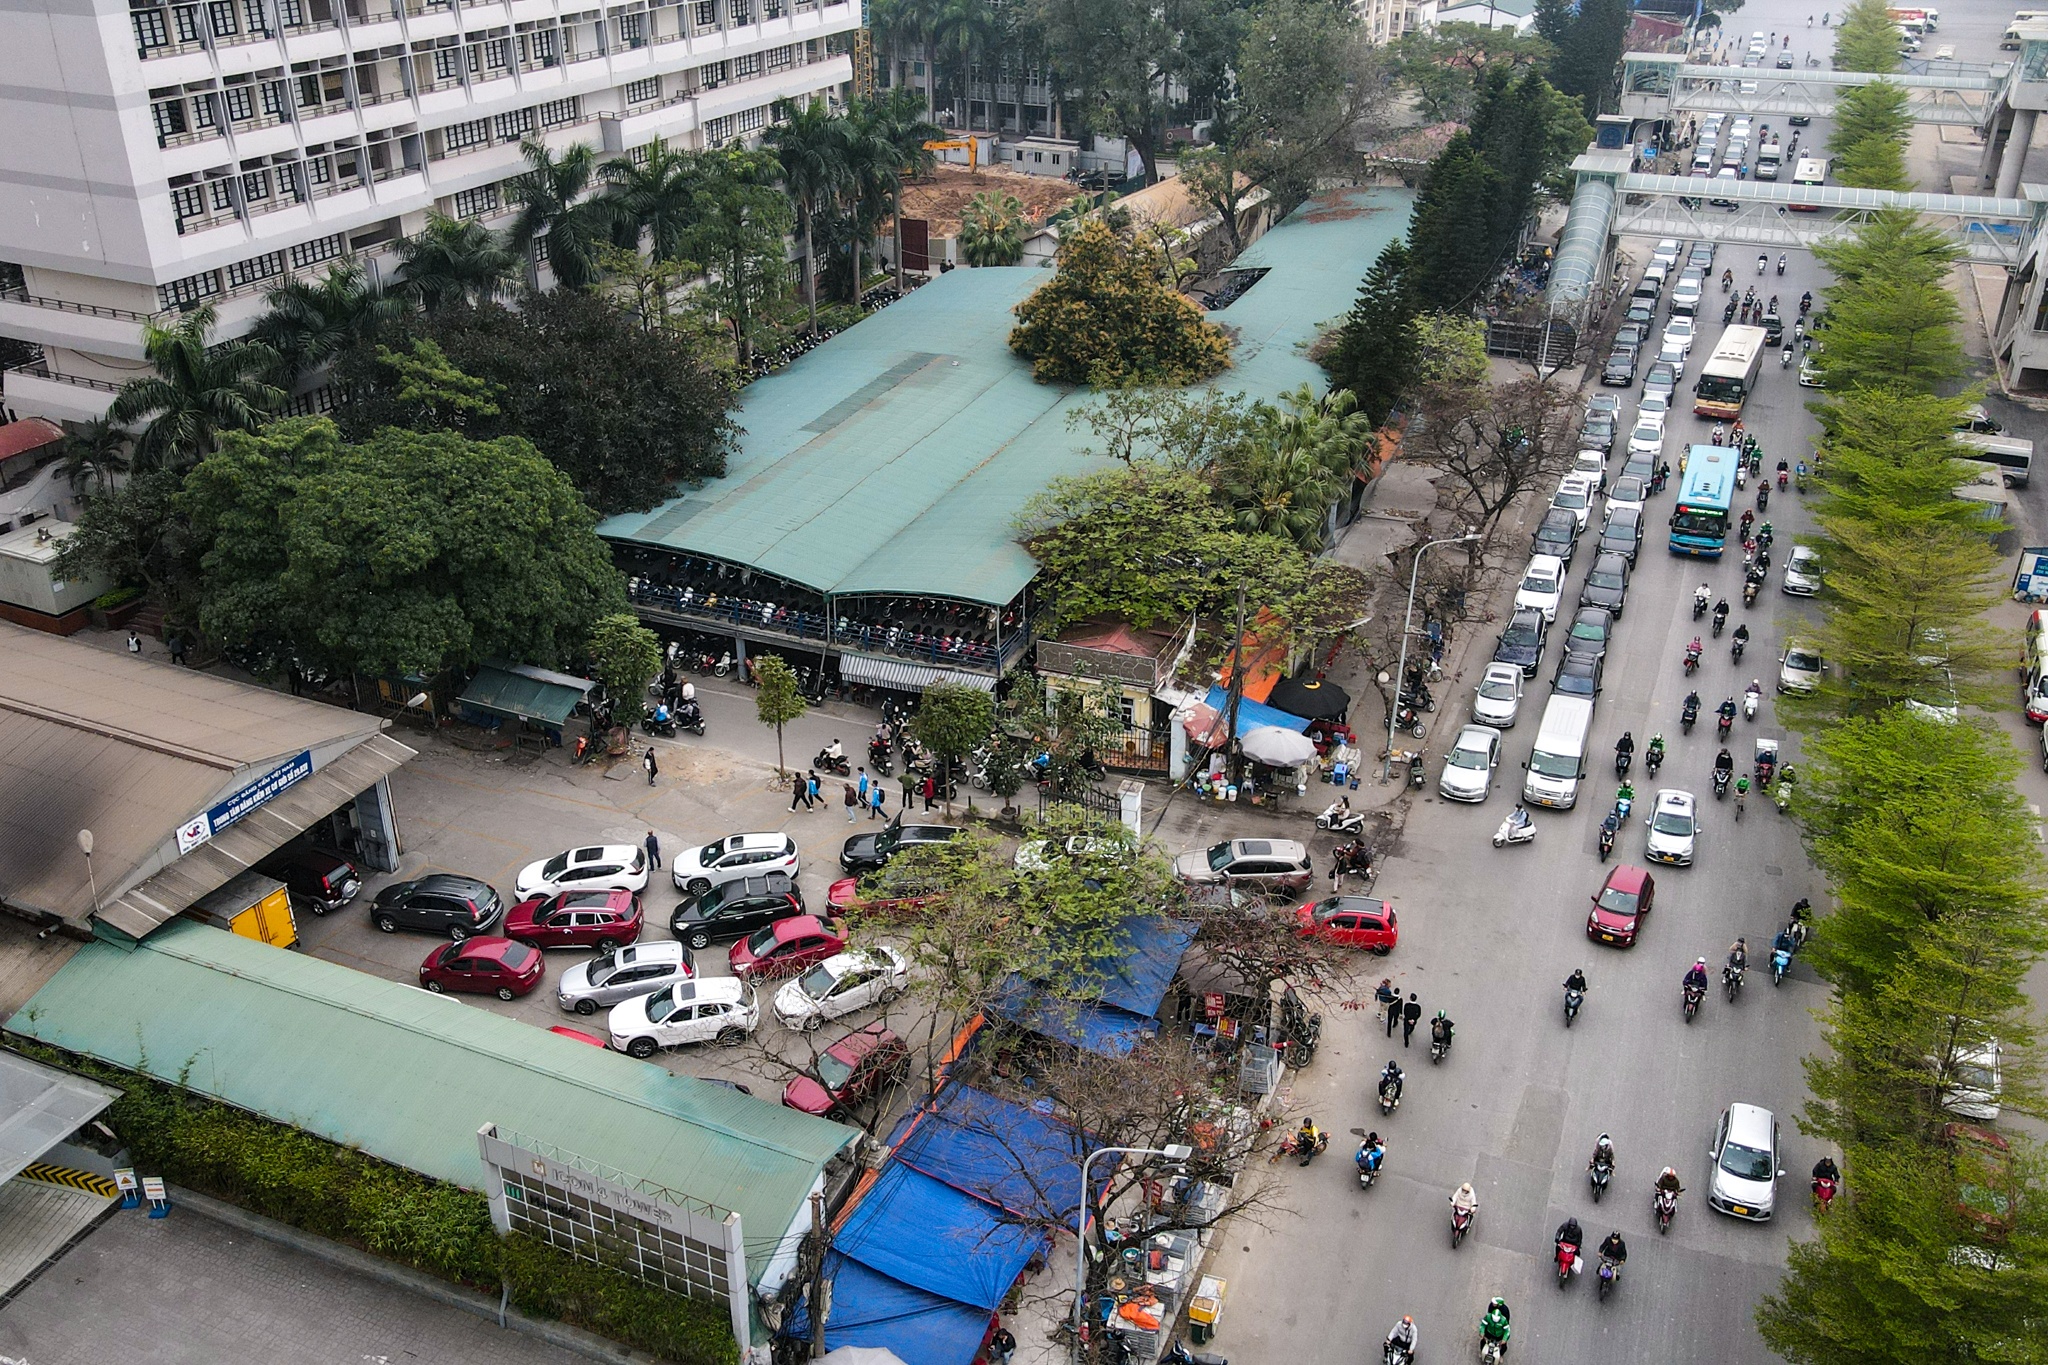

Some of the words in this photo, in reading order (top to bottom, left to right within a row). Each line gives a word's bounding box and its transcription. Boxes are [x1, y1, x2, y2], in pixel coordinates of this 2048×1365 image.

[552, 1168, 595, 1195] ICON
[597, 1186, 609, 1199] 4
[610, 1190, 673, 1225] TOWER
